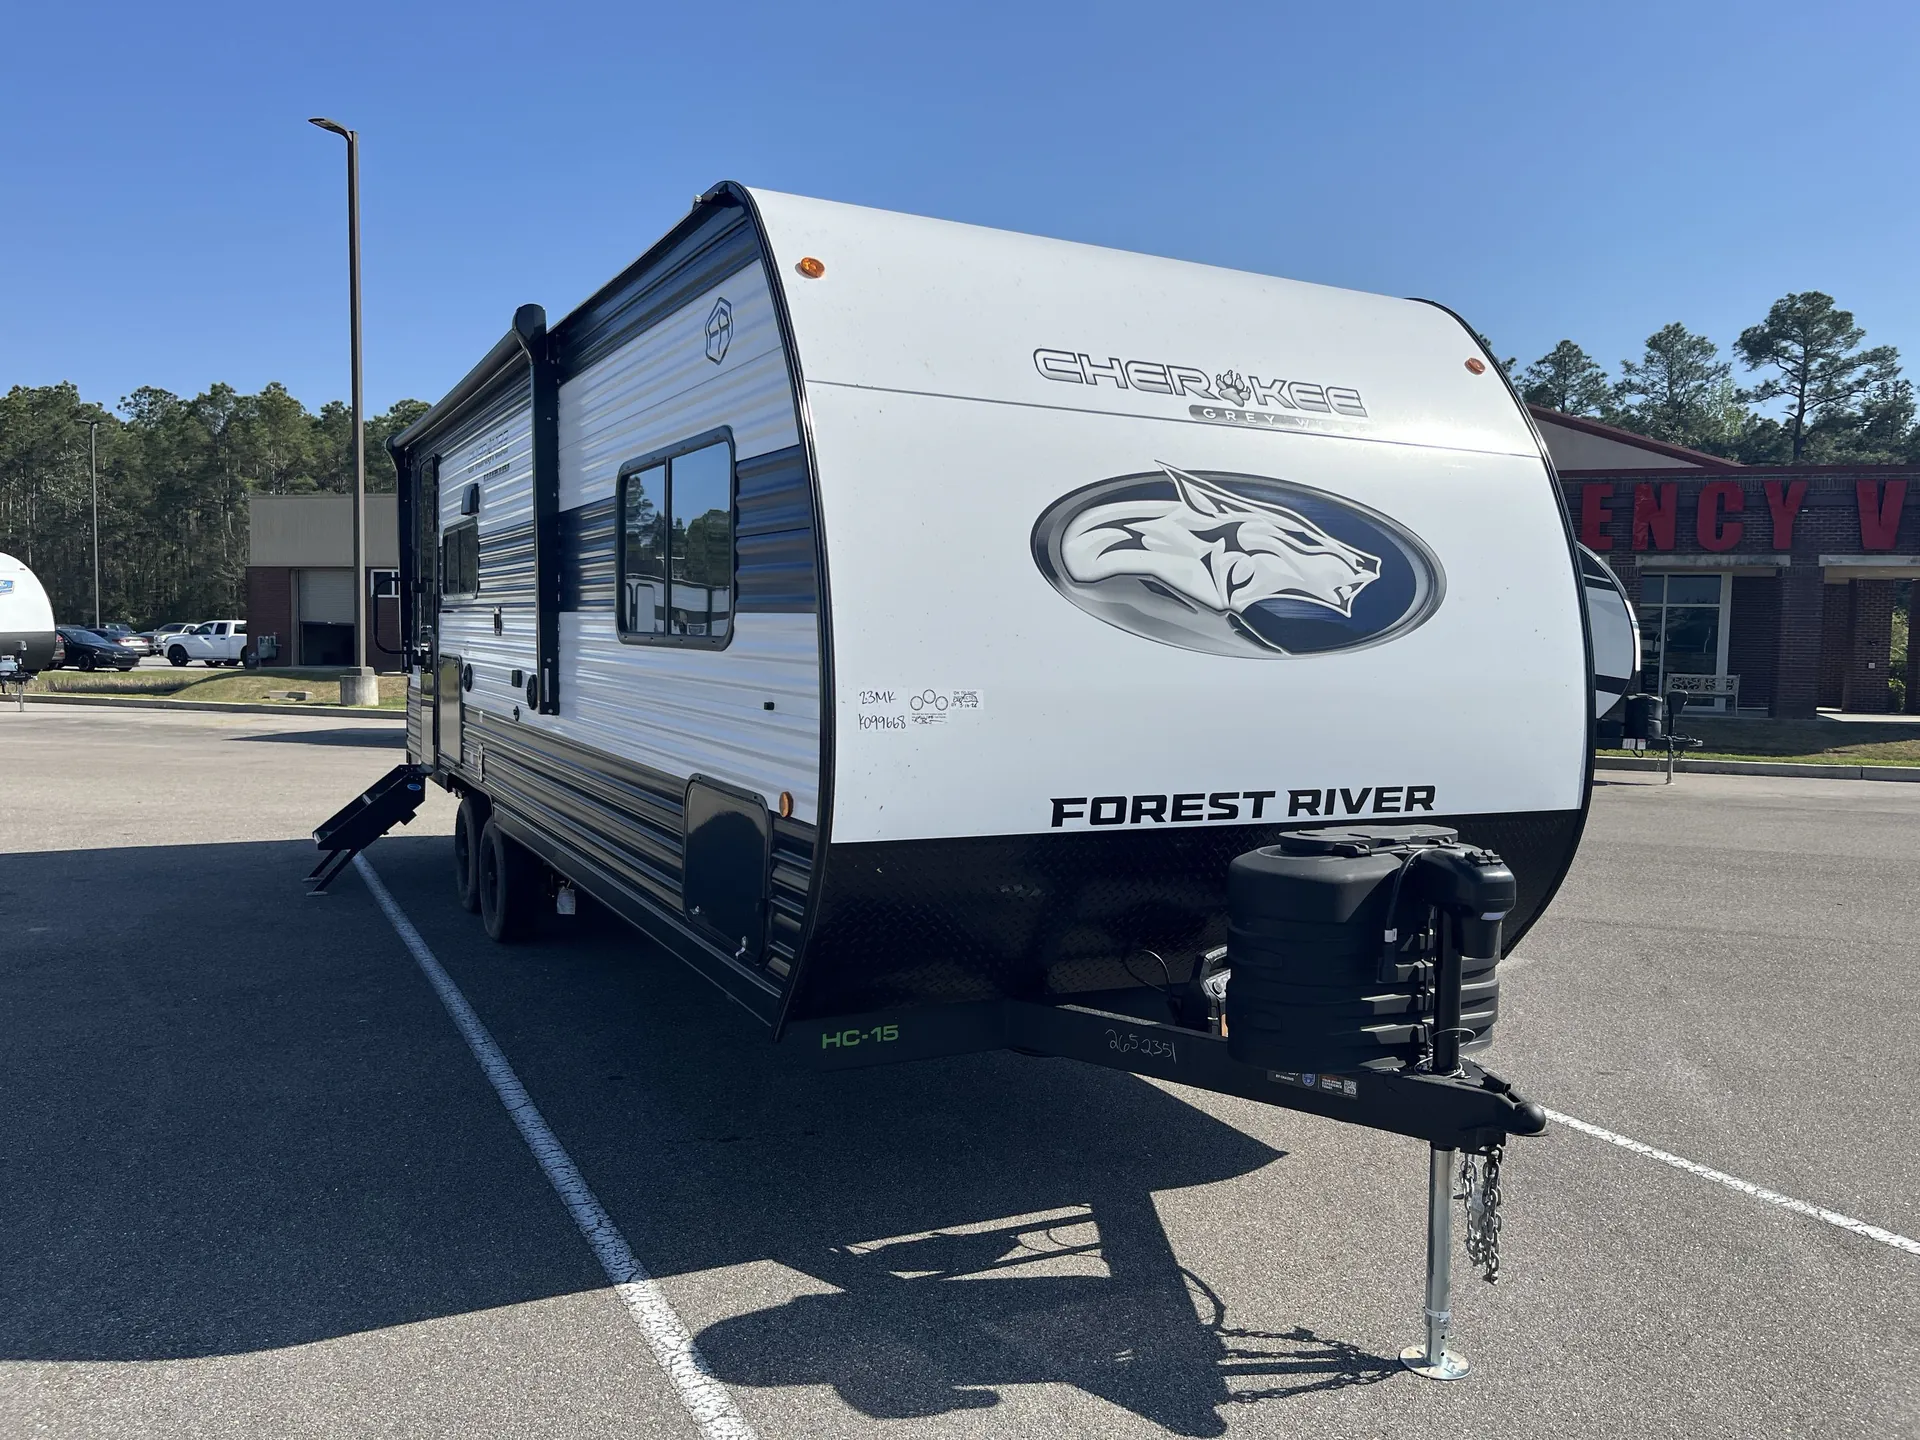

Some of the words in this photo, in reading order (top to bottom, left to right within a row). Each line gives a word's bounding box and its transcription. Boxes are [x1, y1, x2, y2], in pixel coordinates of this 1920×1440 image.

[1202, 408, 1276, 426] GREY
[859, 690, 897, 704] 23MK
[1050, 791, 1275, 827] FOREST
[1287, 785, 1436, 817] RIVER
[822, 1025, 899, 1049] HC-15
